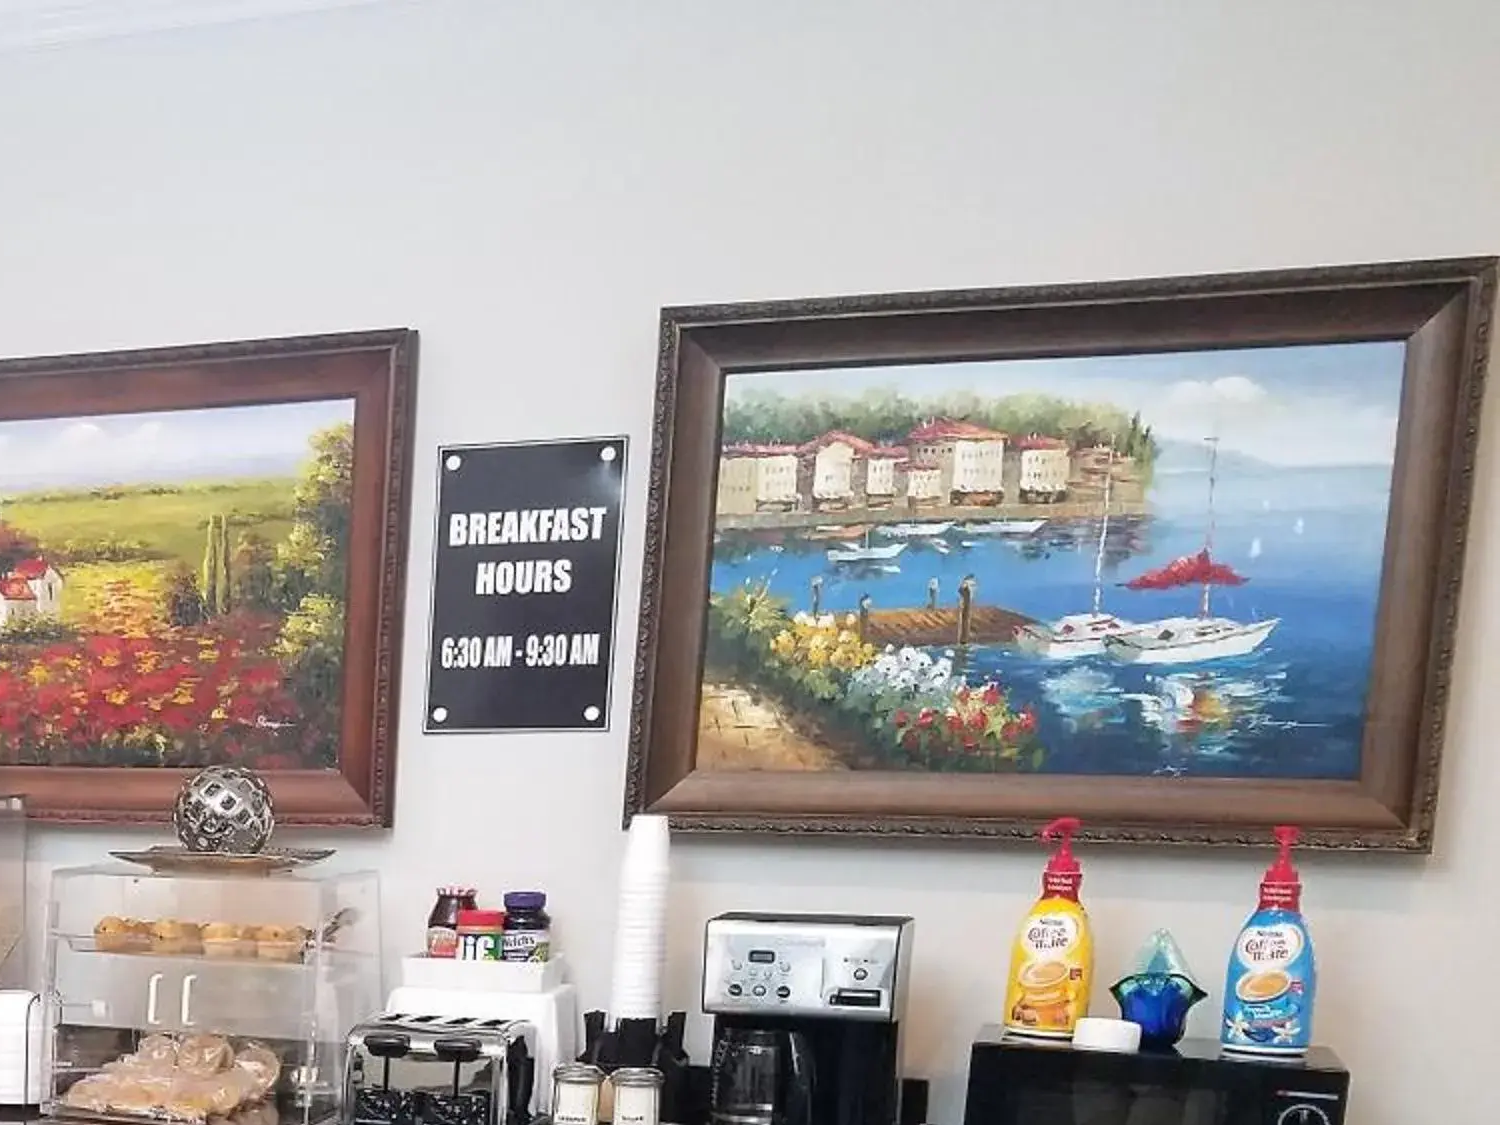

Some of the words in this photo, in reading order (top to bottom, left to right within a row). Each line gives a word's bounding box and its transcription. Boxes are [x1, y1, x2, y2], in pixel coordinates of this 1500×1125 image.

[449, 507, 607, 546] BREAKFAST
[475, 559, 573, 595] HOURS
[441, 637, 482, 669] 6:30
[483, 635, 513, 668] AM
[525, 634, 568, 668] 9:30
[569, 633, 600, 666] AM
